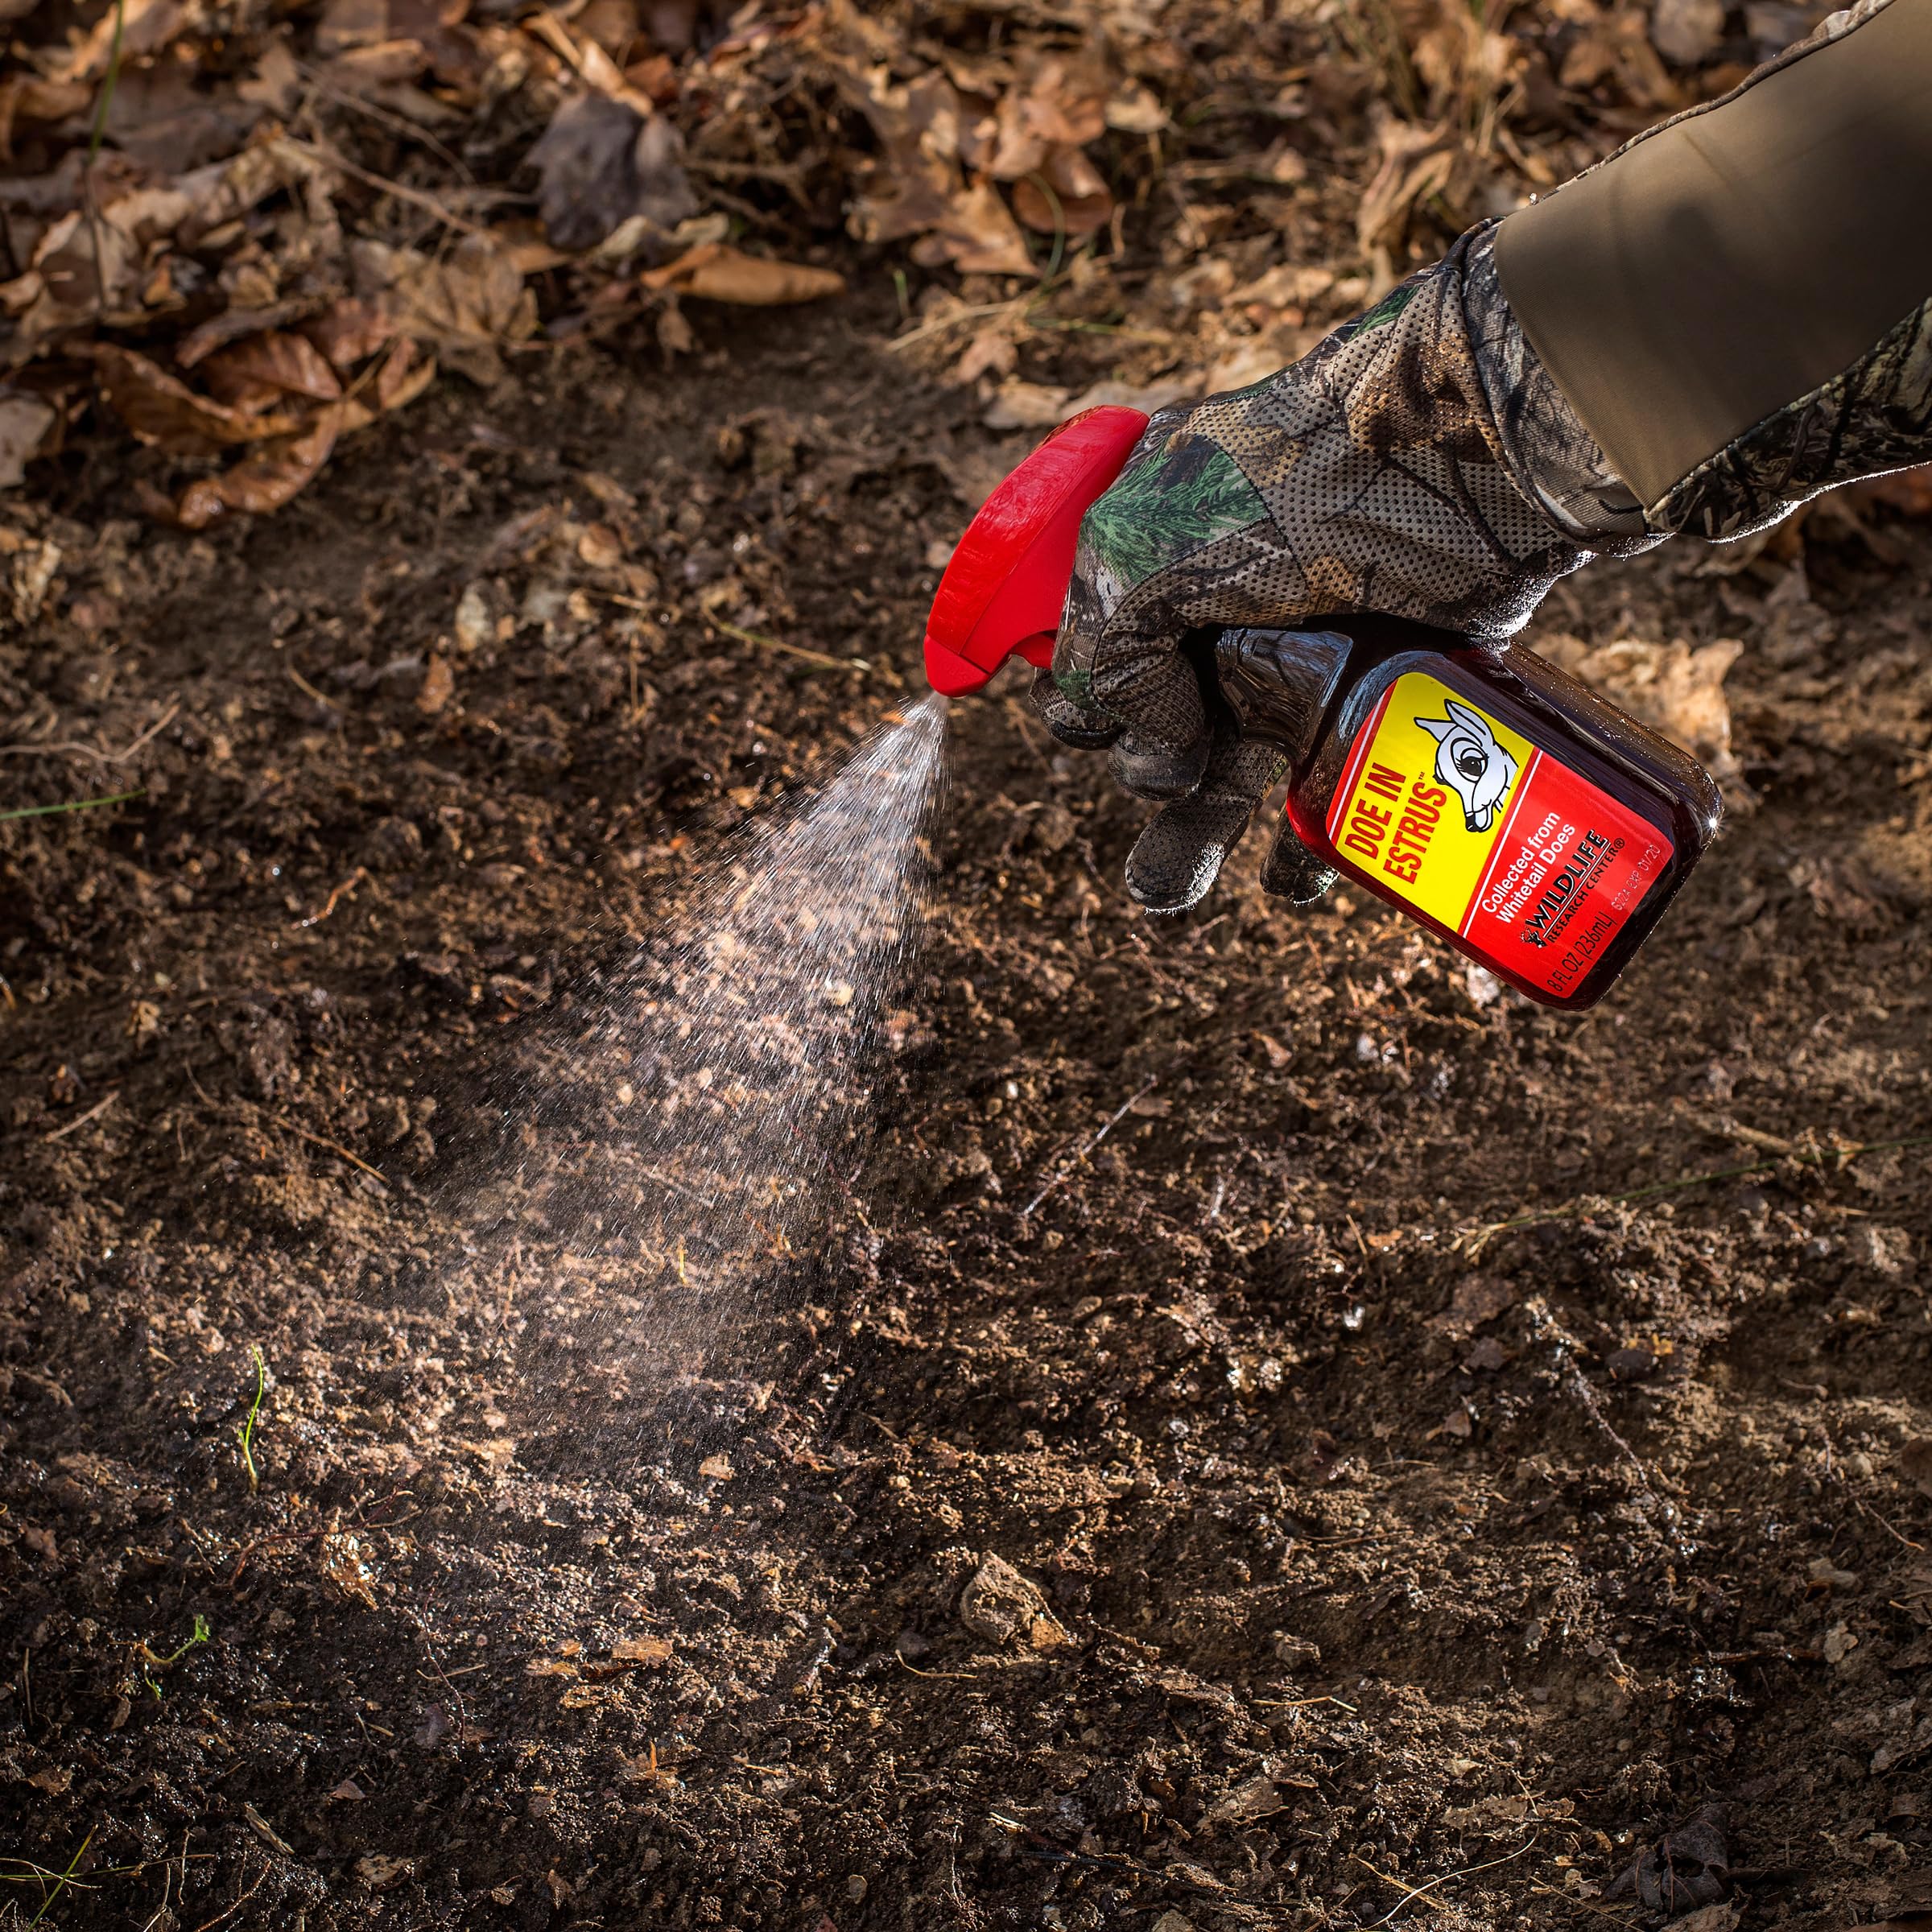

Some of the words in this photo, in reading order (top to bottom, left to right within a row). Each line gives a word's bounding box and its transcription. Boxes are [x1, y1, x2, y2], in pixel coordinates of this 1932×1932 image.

[1364, 762, 1406, 802] IN
[1344, 799, 1392, 860] DOE
[1481, 846, 1535, 913] Collected
[1527, 811, 1561, 849] from
[1496, 863, 1547, 923] Whitetail
[1539, 823, 1575, 865] Does
[1525, 829, 1608, 930] WILDLIFE
[1547, 891, 1589, 943] RESEARCH
[1573, 911, 1617, 960] (236mL)
[1546, 978, 1563, 992] 8
[1552, 969, 1572, 985] FL
[1562, 952, 1583, 973] OZ
